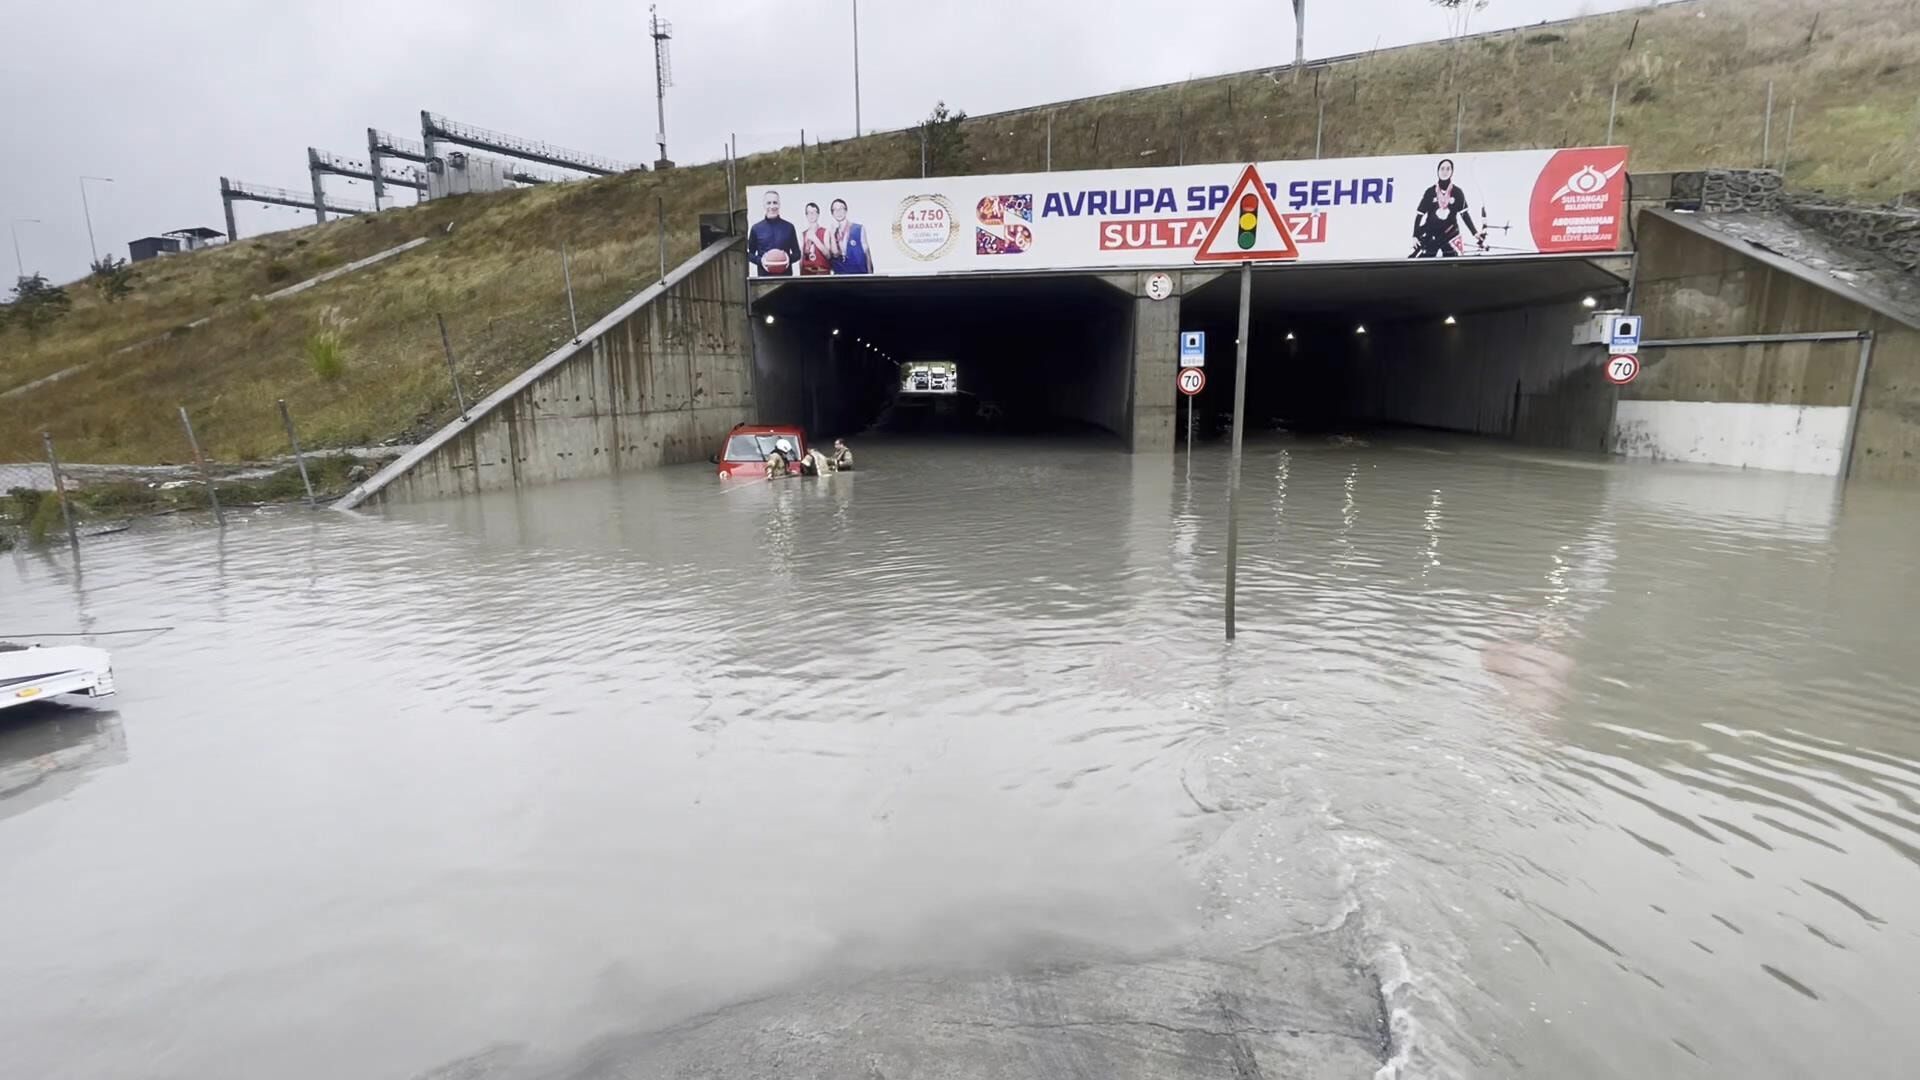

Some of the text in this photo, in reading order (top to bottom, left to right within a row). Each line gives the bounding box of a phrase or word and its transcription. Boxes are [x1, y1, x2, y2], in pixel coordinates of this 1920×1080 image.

[1042, 177, 1394, 217] AVRUPA SP ŞEHRİ
[907, 209, 944, 221] 4.750
[1104, 210, 1320, 248] SULTAZİ
[1152, 281, 1159, 292] 5
[1614, 362, 1632, 376] 70
[1184, 375, 1199, 388] 70
